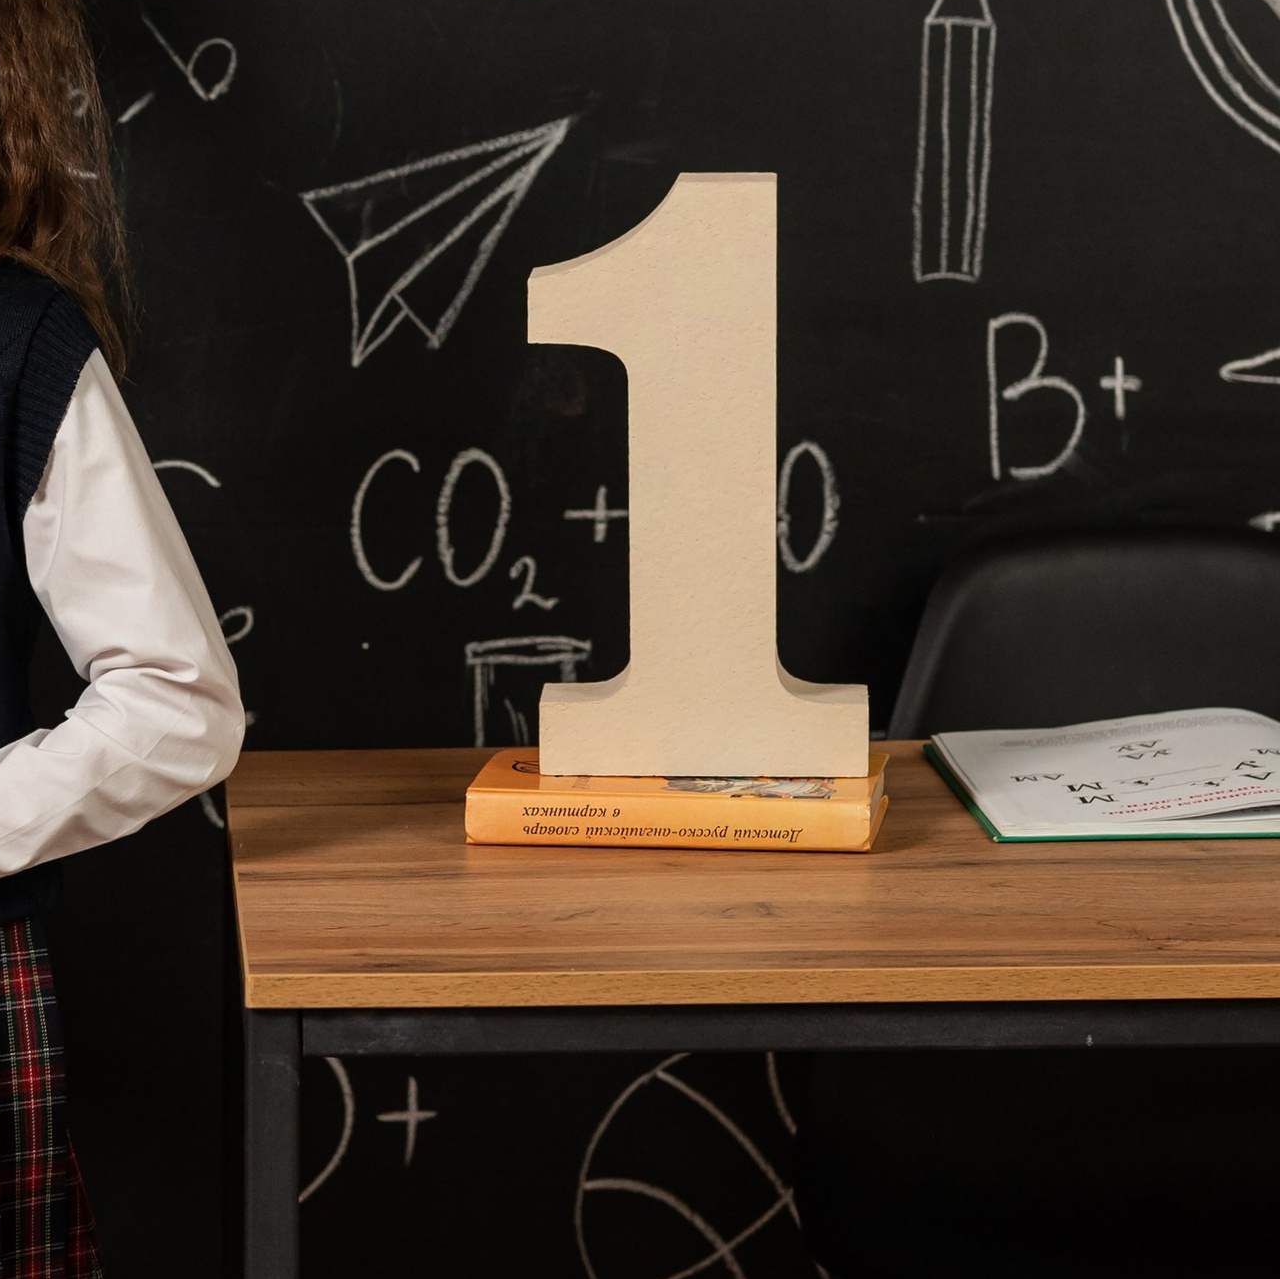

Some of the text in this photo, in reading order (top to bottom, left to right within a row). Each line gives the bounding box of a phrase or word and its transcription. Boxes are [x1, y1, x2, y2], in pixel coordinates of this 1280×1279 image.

[522, 804, 622, 824] в картинках
[522, 822, 804, 845] Детский русско-английский словарь
